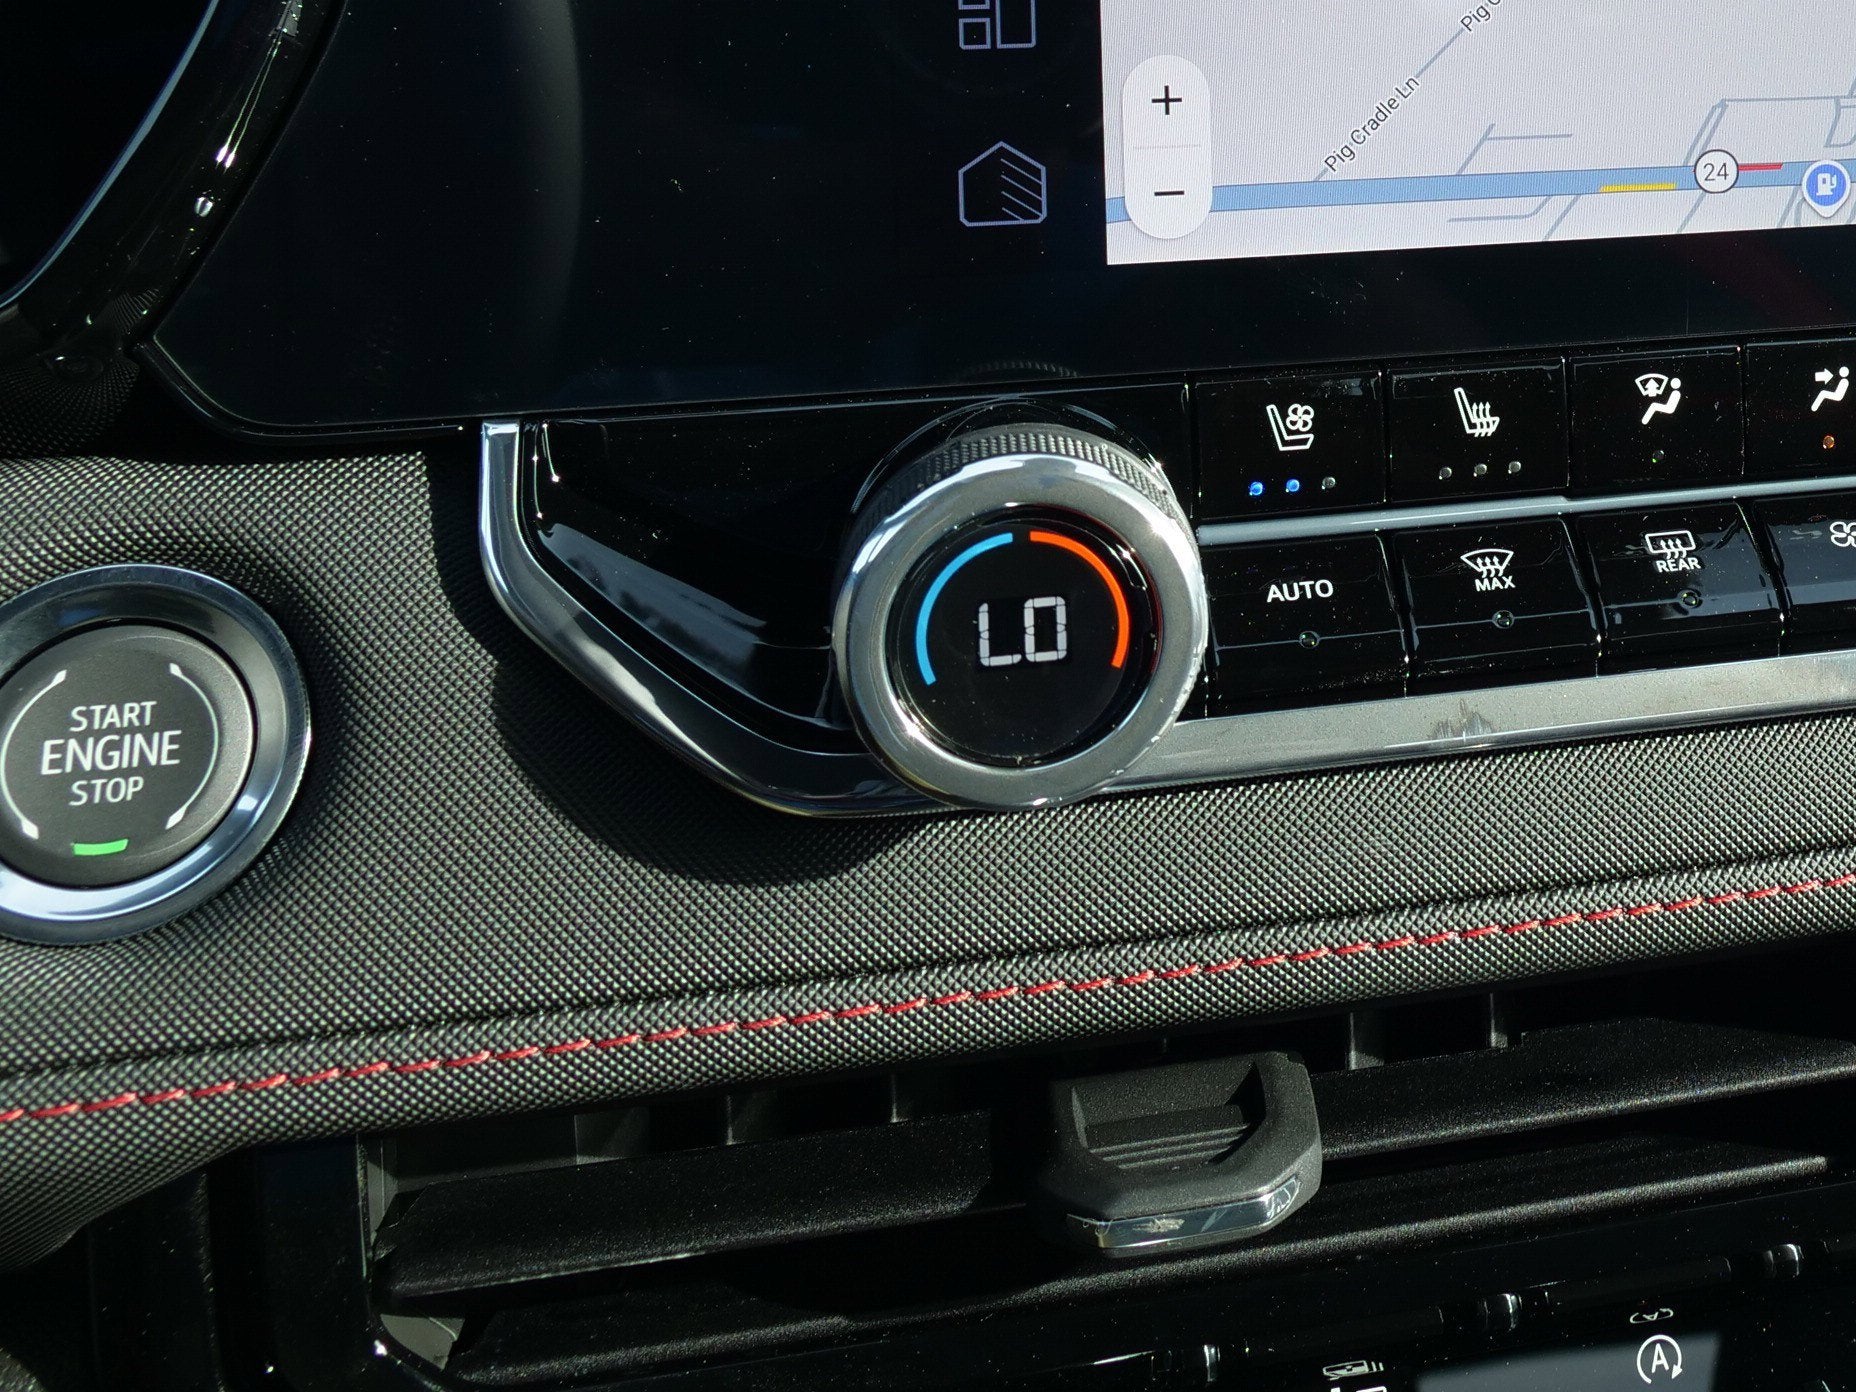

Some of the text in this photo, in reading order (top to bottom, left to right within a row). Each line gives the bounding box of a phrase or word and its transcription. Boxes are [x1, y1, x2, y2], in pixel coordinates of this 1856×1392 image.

[1460, 4, 1491, 32] Pig
[1324, 77, 1420, 173] Pig Cradle Ln
[1702, 161, 1731, 183] 24
[1655, 554, 1702, 574] REAR
[1266, 578, 1334, 604] AUTO
[1474, 574, 1516, 592] MAX
[977, 595, 1069, 668] LO
[69, 701, 158, 733] START
[40, 729, 182, 776] ENGINE
[68, 776, 145, 807] STOP
